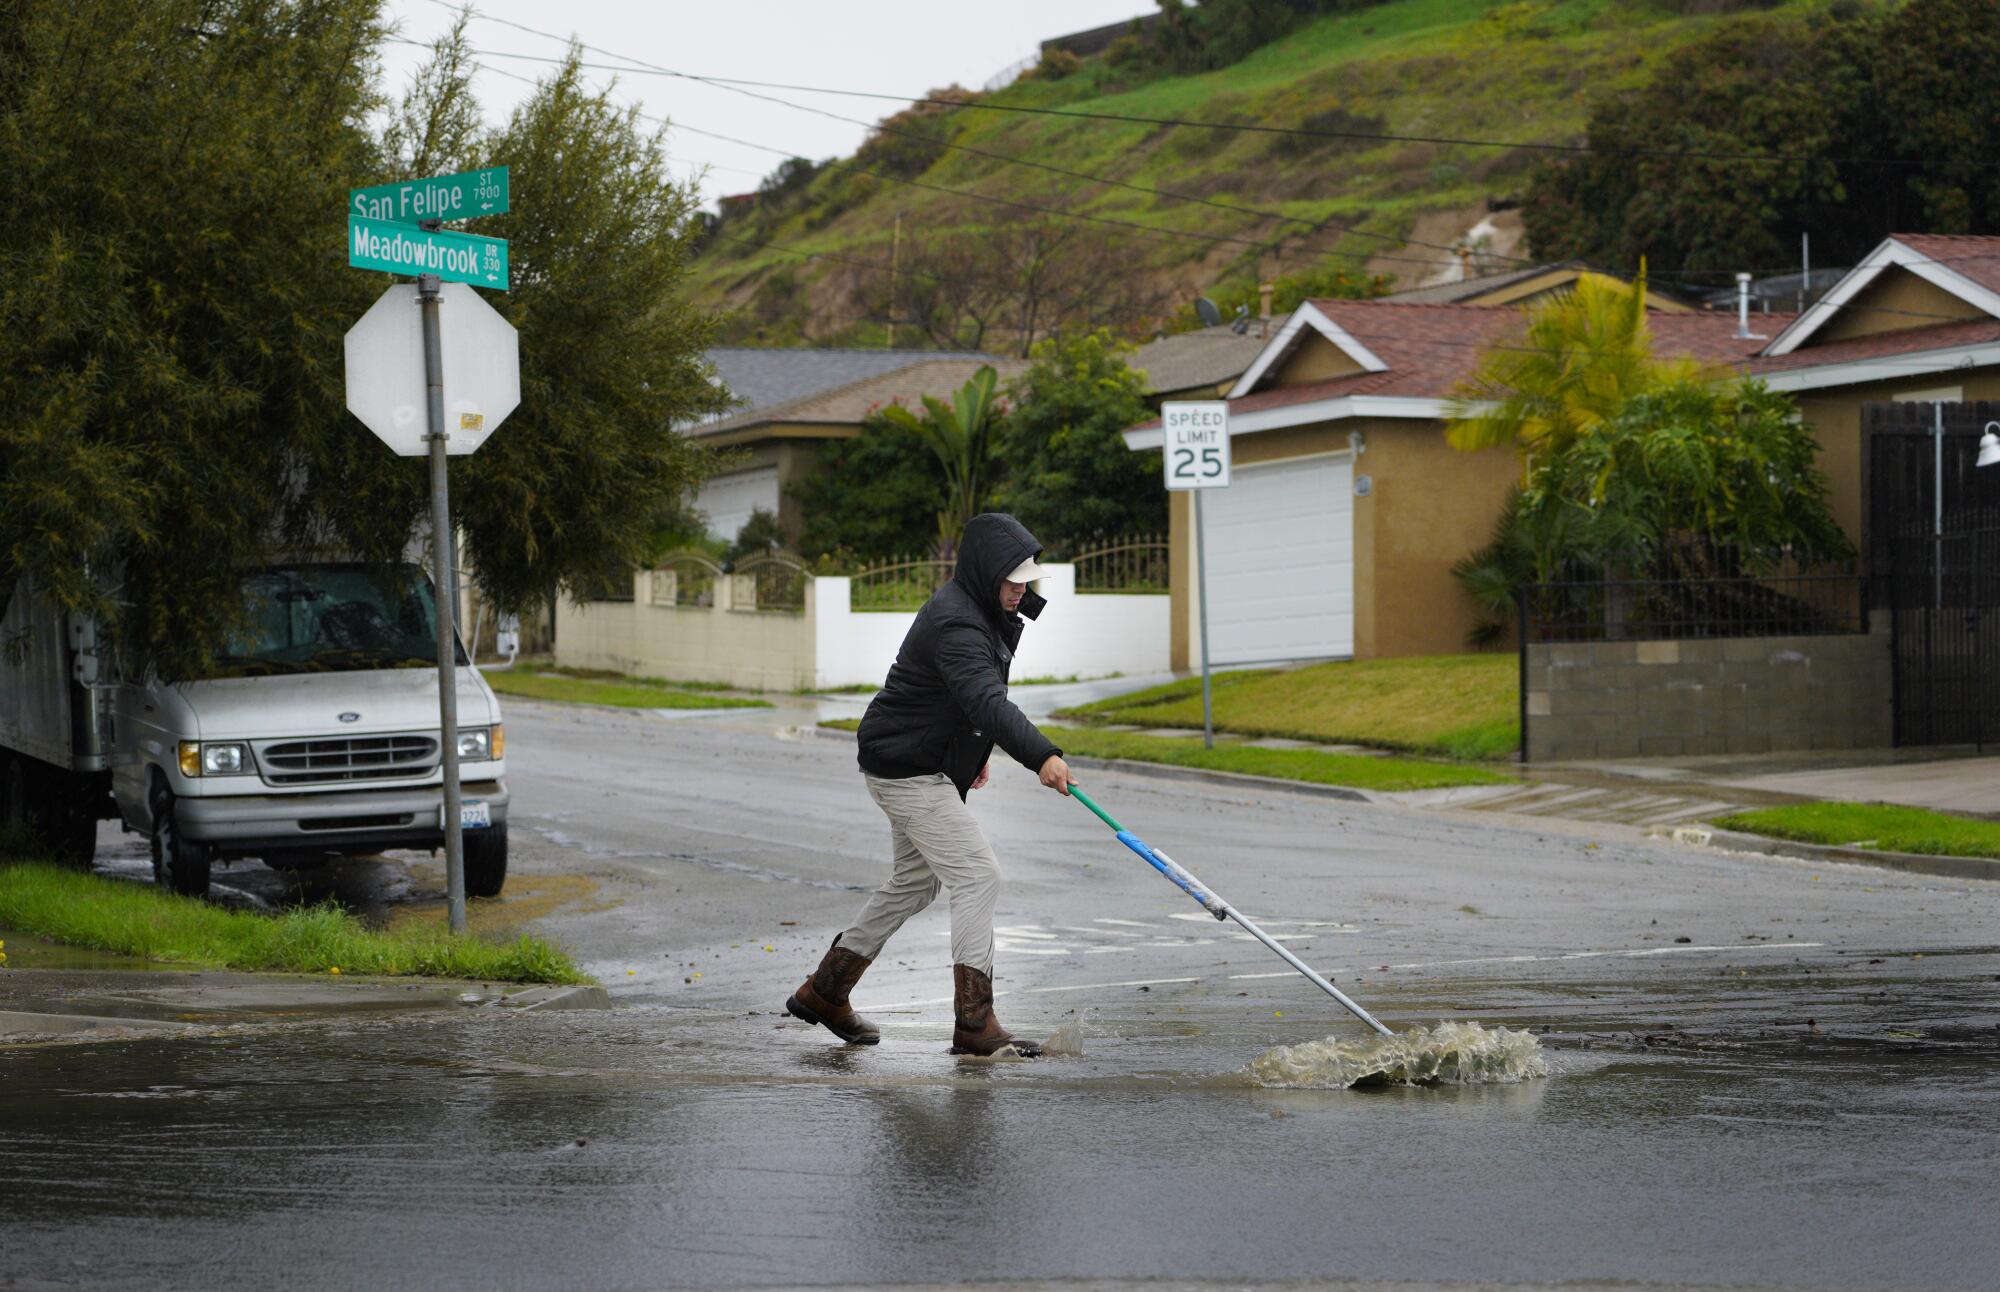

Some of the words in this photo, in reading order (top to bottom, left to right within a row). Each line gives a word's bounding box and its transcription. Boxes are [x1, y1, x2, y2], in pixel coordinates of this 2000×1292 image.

[479, 172, 493, 186] ST
[473, 185, 500, 200] 7900
[354, 193, 393, 220] San
[400, 184, 463, 218] Felipe
[354, 225, 479, 275] Meadowbrook
[485, 244, 498, 257] DR
[483, 258, 500, 272] 330
[1169, 412, 1223, 426] SPEED
[1177, 430, 1217, 443] LIMIT
[1174, 448, 1222, 477] 25
